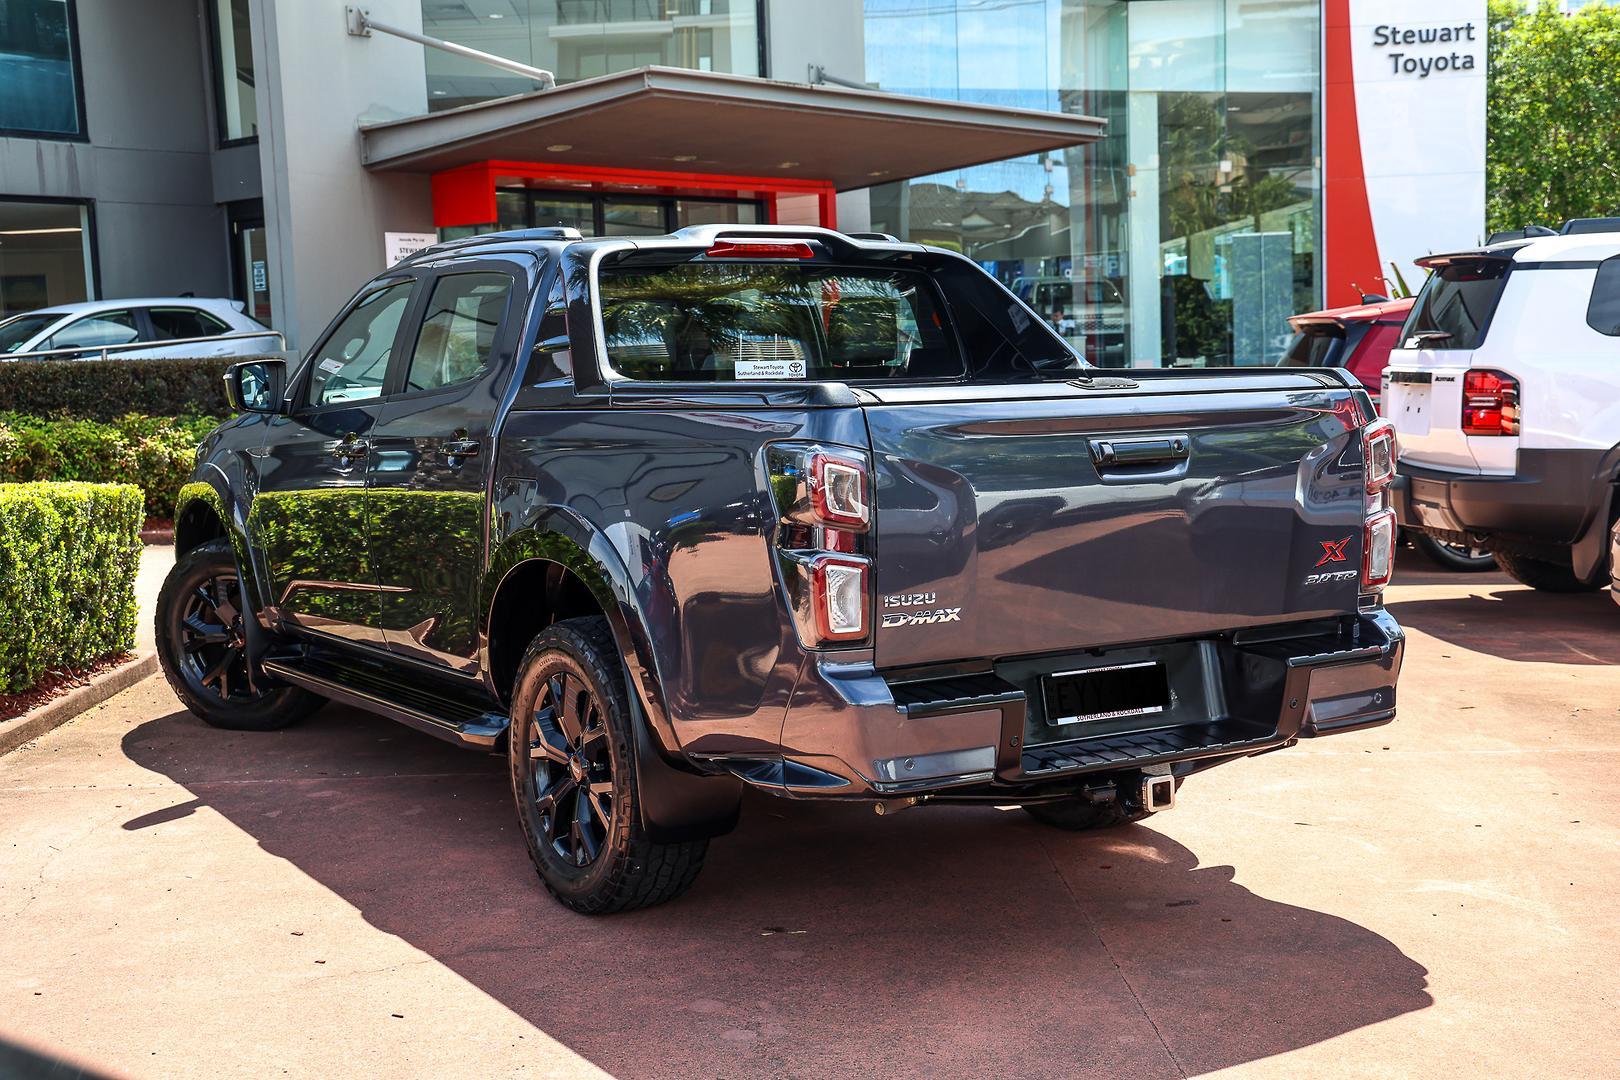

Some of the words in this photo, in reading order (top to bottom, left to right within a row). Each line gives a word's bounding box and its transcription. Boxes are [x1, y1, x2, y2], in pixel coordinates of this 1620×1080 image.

[1374, 22, 1475, 46] Stewart
[1388, 52, 1475, 78] Toyota
[884, 592, 936, 608] ISUZU
[882, 607, 962, 628] D-MAX
